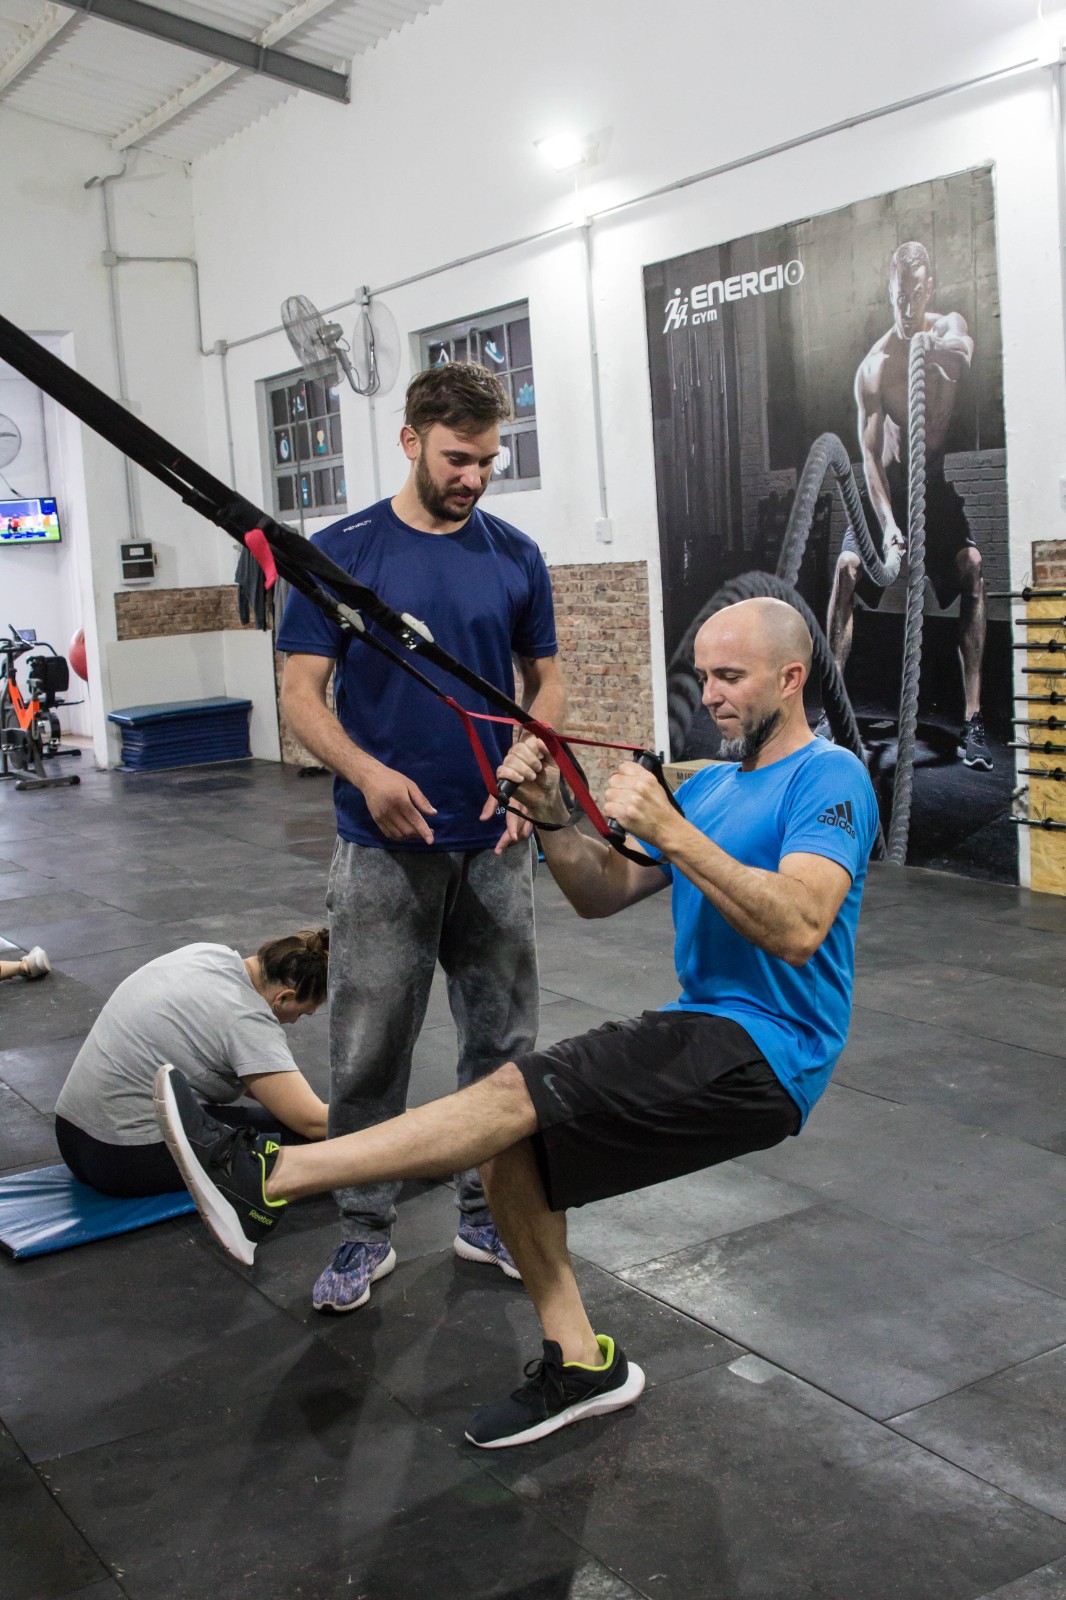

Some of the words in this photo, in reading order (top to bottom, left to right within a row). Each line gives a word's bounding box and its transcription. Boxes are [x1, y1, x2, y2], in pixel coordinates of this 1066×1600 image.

[691, 260, 804, 309] ENERGIO
[692, 309, 717, 325] GYM
[817, 814, 856, 839] adidas
[249, 1209, 273, 1226] Reebok
